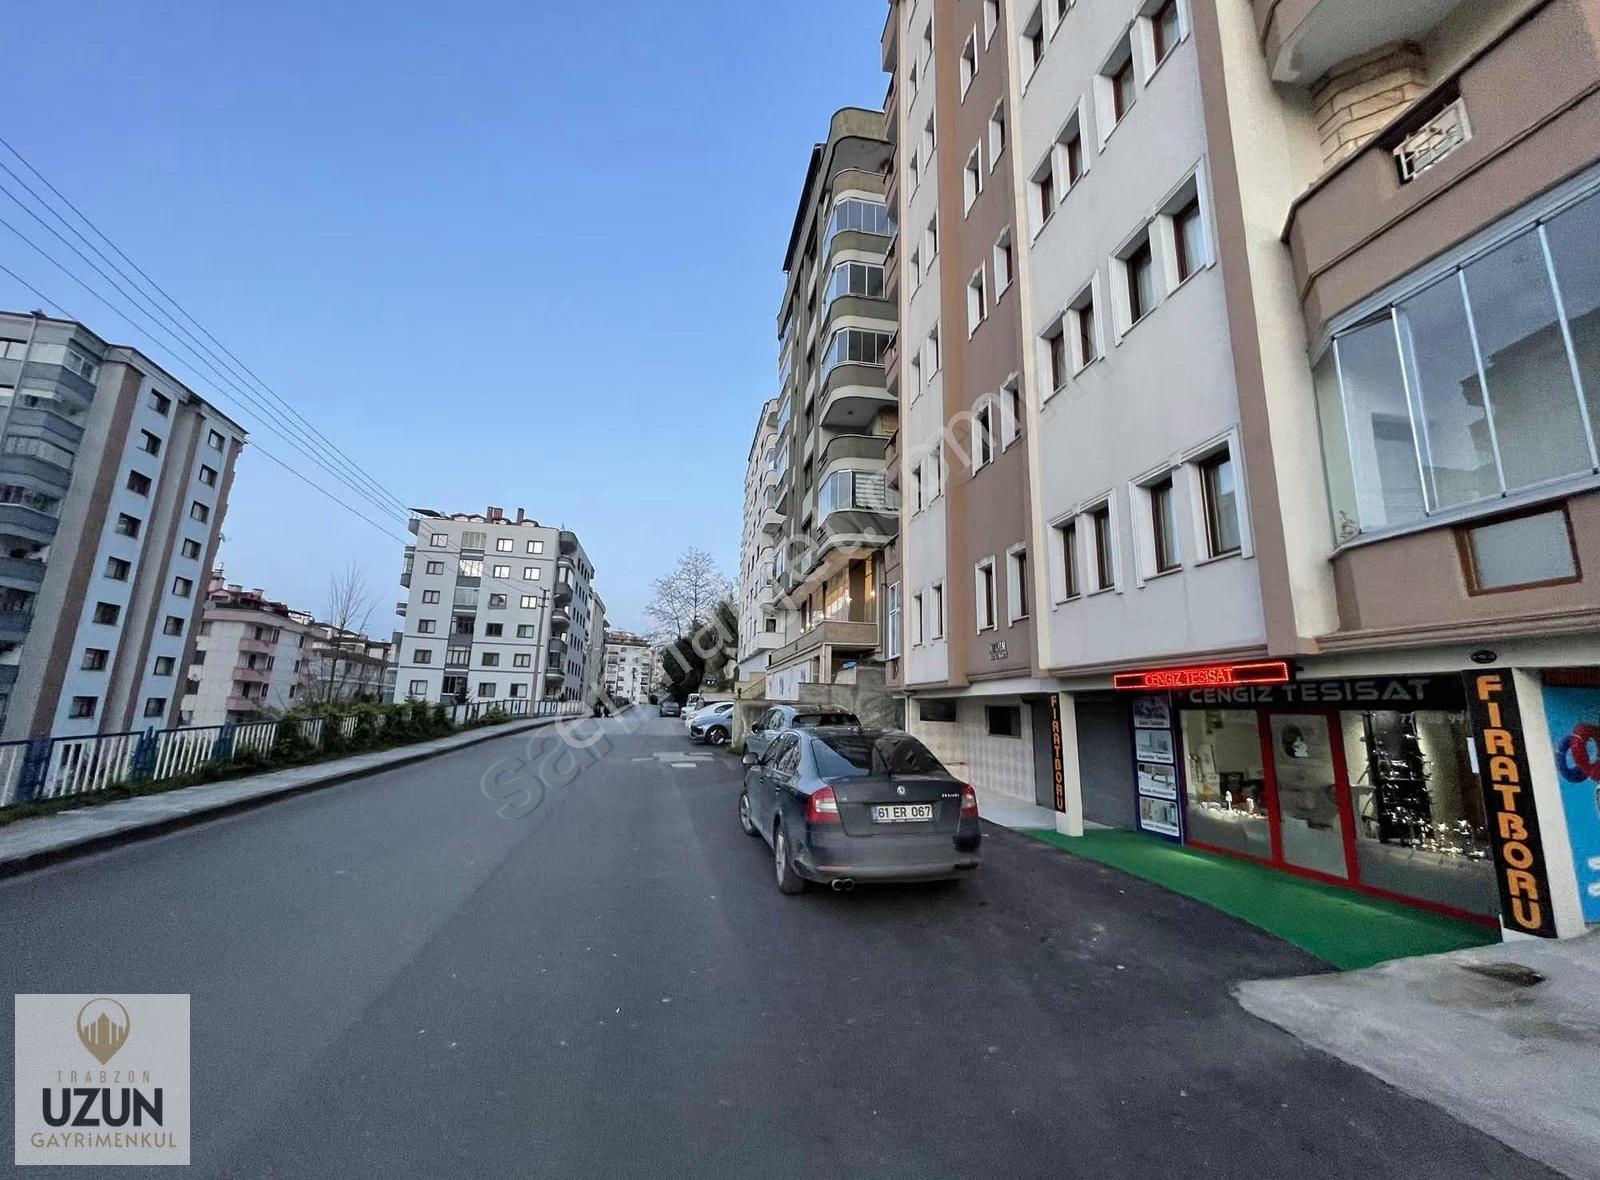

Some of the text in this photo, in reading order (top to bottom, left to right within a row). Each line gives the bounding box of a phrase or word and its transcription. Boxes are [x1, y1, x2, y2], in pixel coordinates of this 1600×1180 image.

[878, 805, 931, 818] 61 ER 067
[1476, 674, 1542, 930] FIRATBORU
